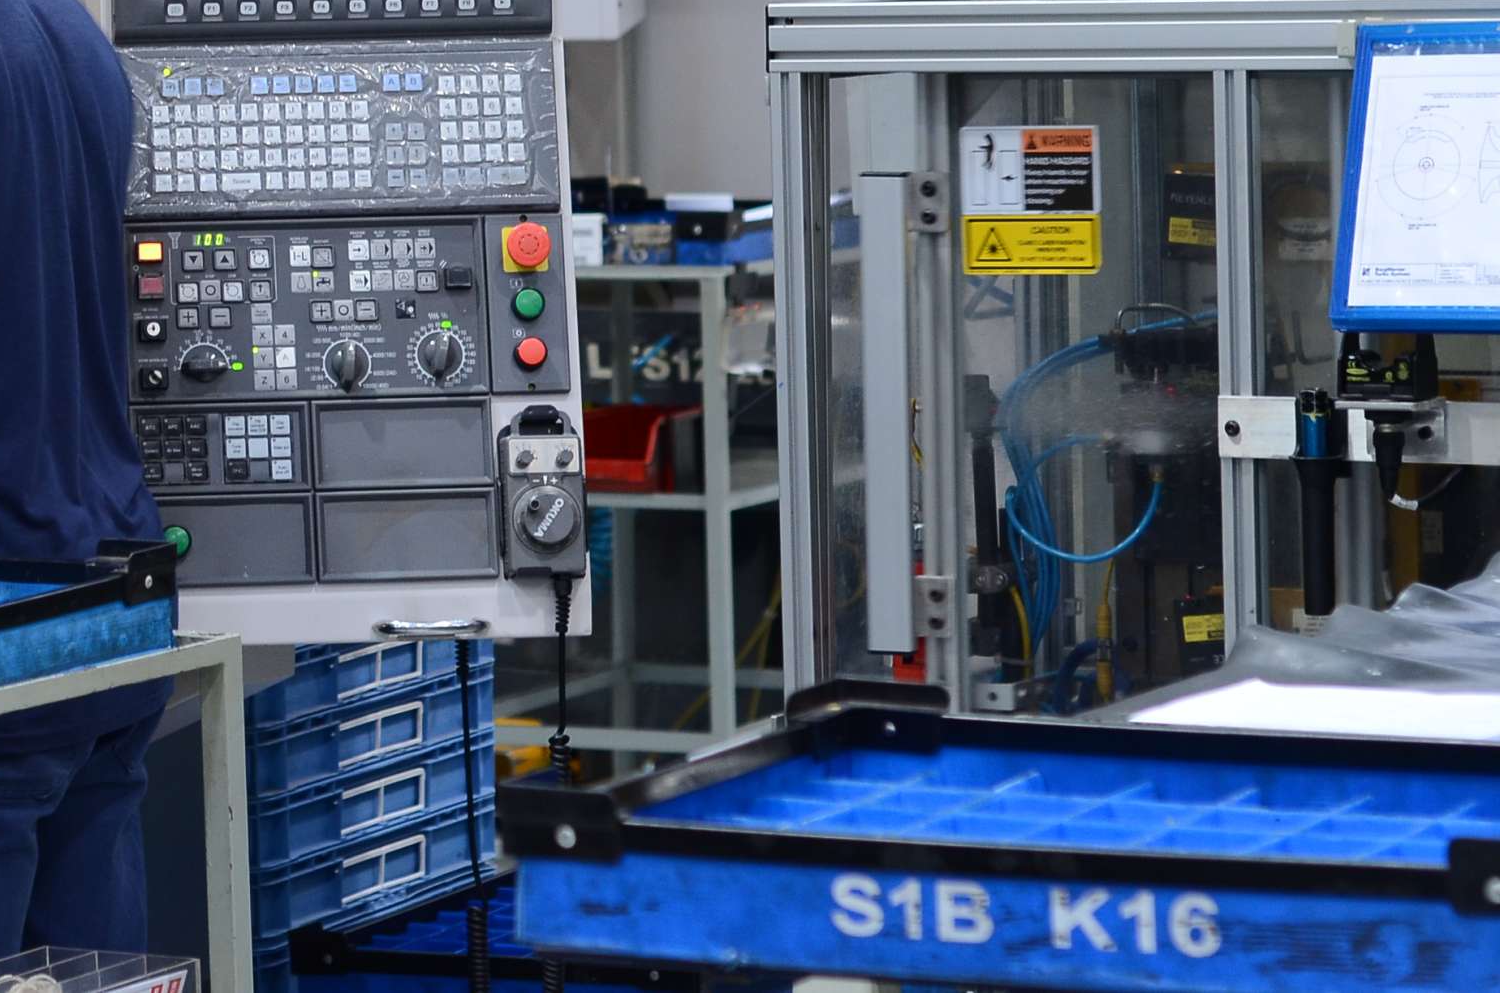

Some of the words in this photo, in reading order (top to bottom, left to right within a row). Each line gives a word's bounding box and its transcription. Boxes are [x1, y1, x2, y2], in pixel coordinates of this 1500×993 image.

[1041, 134, 1091, 148] WARNING
[1031, 226, 1071, 235] CAUTION
[196, 234, 223, 246] 100
[534, 497, 564, 538] OKUMA
[831, 875, 997, 946] S1B
[1048, 888, 1223, 959] K16
